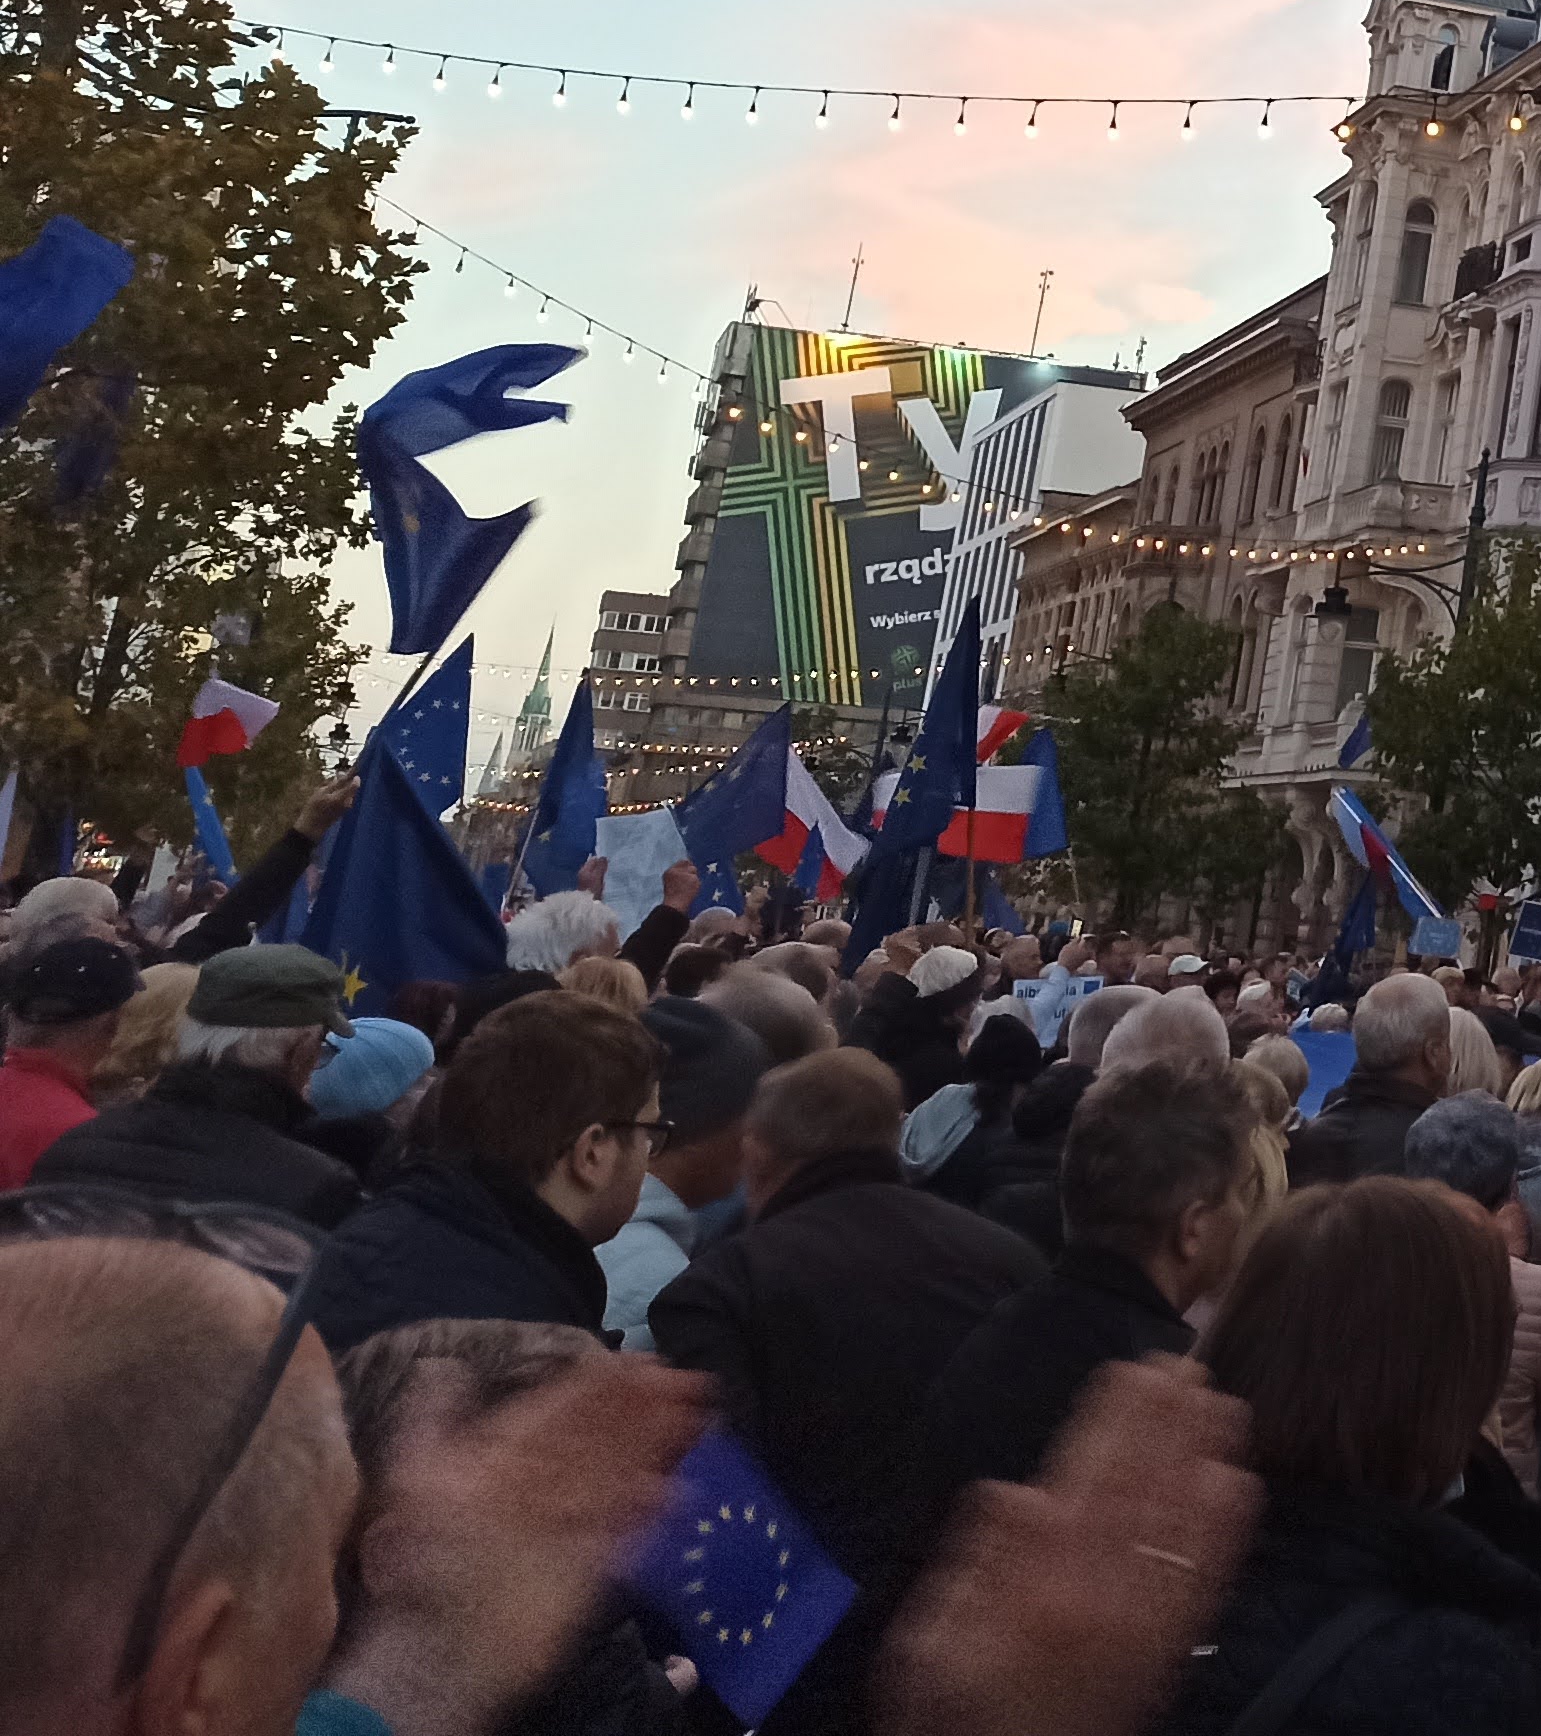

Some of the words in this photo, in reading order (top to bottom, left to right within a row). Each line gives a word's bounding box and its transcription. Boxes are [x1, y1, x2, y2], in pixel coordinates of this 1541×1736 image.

[780, 367, 1003, 531] Ty
[870, 610, 931, 629] Wybierz
[893, 677, 922, 692] plus
